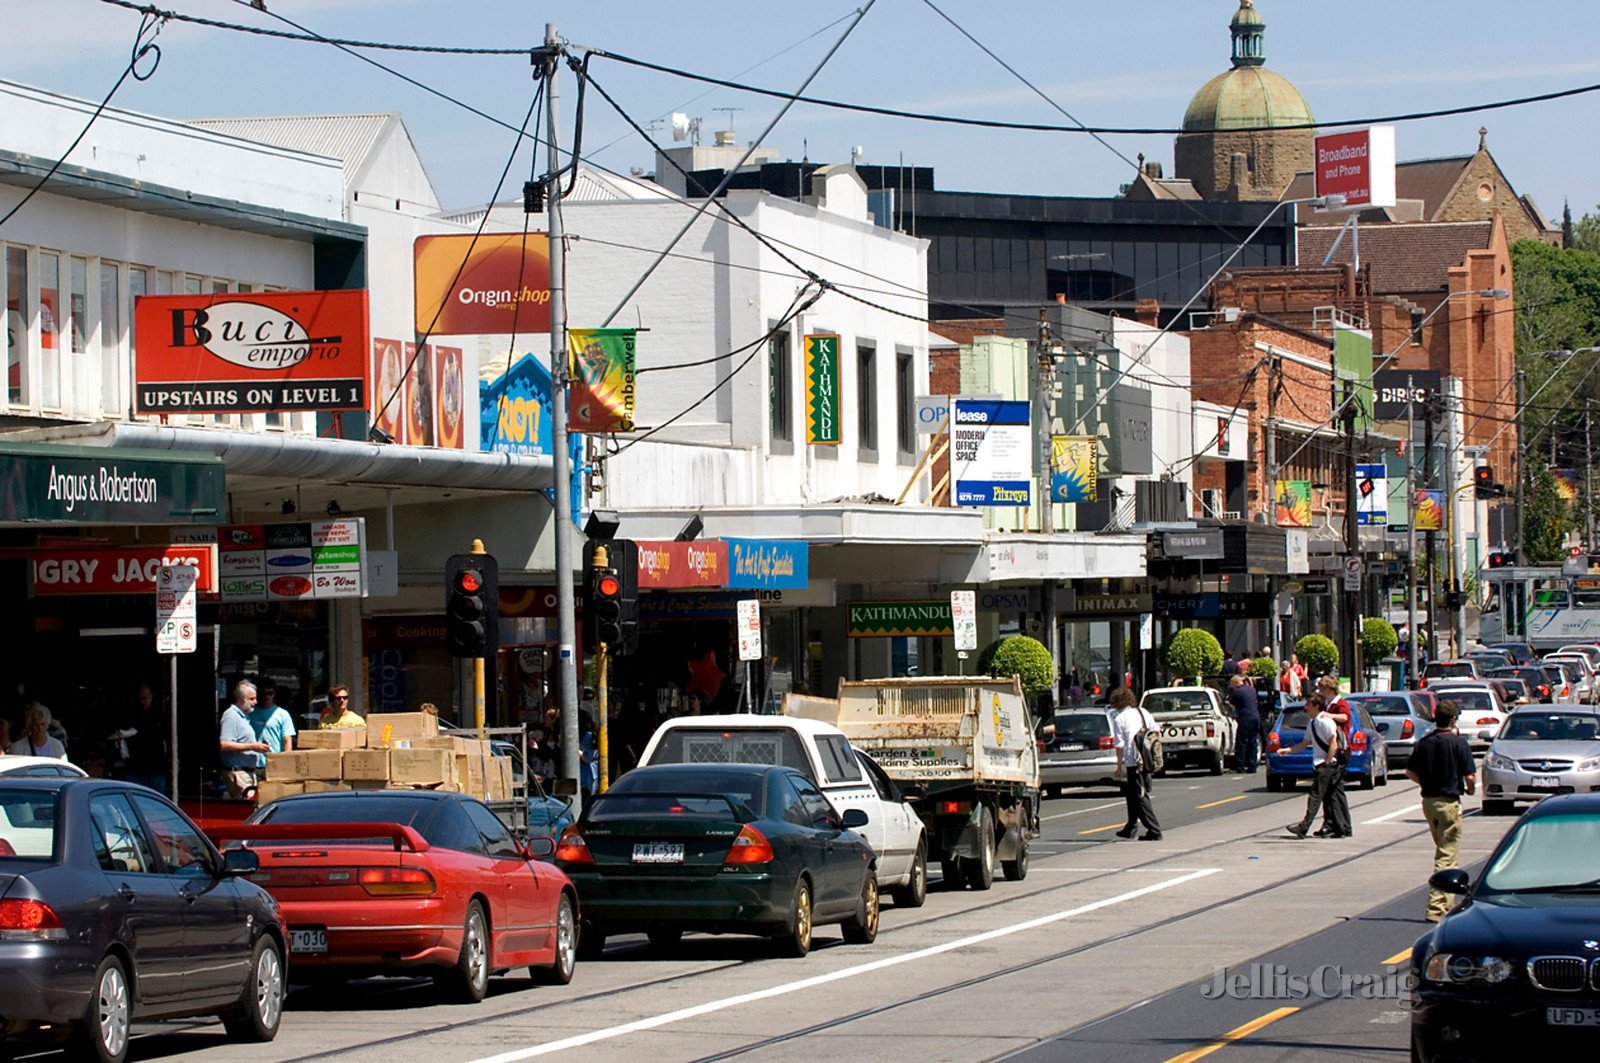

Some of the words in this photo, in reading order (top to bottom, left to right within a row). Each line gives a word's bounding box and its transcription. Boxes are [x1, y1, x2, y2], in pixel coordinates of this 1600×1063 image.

[1319, 142, 1367, 163] Broadband
[1325, 166, 1338, 179] and
[1339, 165, 1361, 177] Phone
[459, 287, 511, 306] Origin
[513, 286, 550, 306] shop
[168, 307, 299, 347] Buci
[248, 346, 341, 366] emporio
[819, 339, 832, 439] KATHMANDU
[1382, 387, 1436, 403] DIREC
[143, 389, 238, 406] UPSTAIRS
[246, 389, 273, 404] ON
[282, 388, 341, 404] LEVEL
[349, 388, 358, 402] 1
[497, 396, 541, 444] RIOT!
[956, 408, 988, 422] lease
[955, 430, 985, 440] MODERN
[955, 440, 979, 451] OFFICE
[955, 451, 978, 462] SPACE
[48, 465, 87, 512] Angus
[89, 474, 99, 501] &
[100, 466, 157, 503] Robertson
[316, 576, 331, 588] Bo
[981, 594, 1028, 609] OPSM
[1075, 598, 1138, 611] INIMAX
[850, 606, 950, 622] KATHMANDU
[1160, 727, 1197, 737] YOTA
[865, 749, 907, 758] Garden
[909, 748, 921, 758] &
[876, 758, 909, 768] uilding
[912, 756, 959, 768] Supplies
